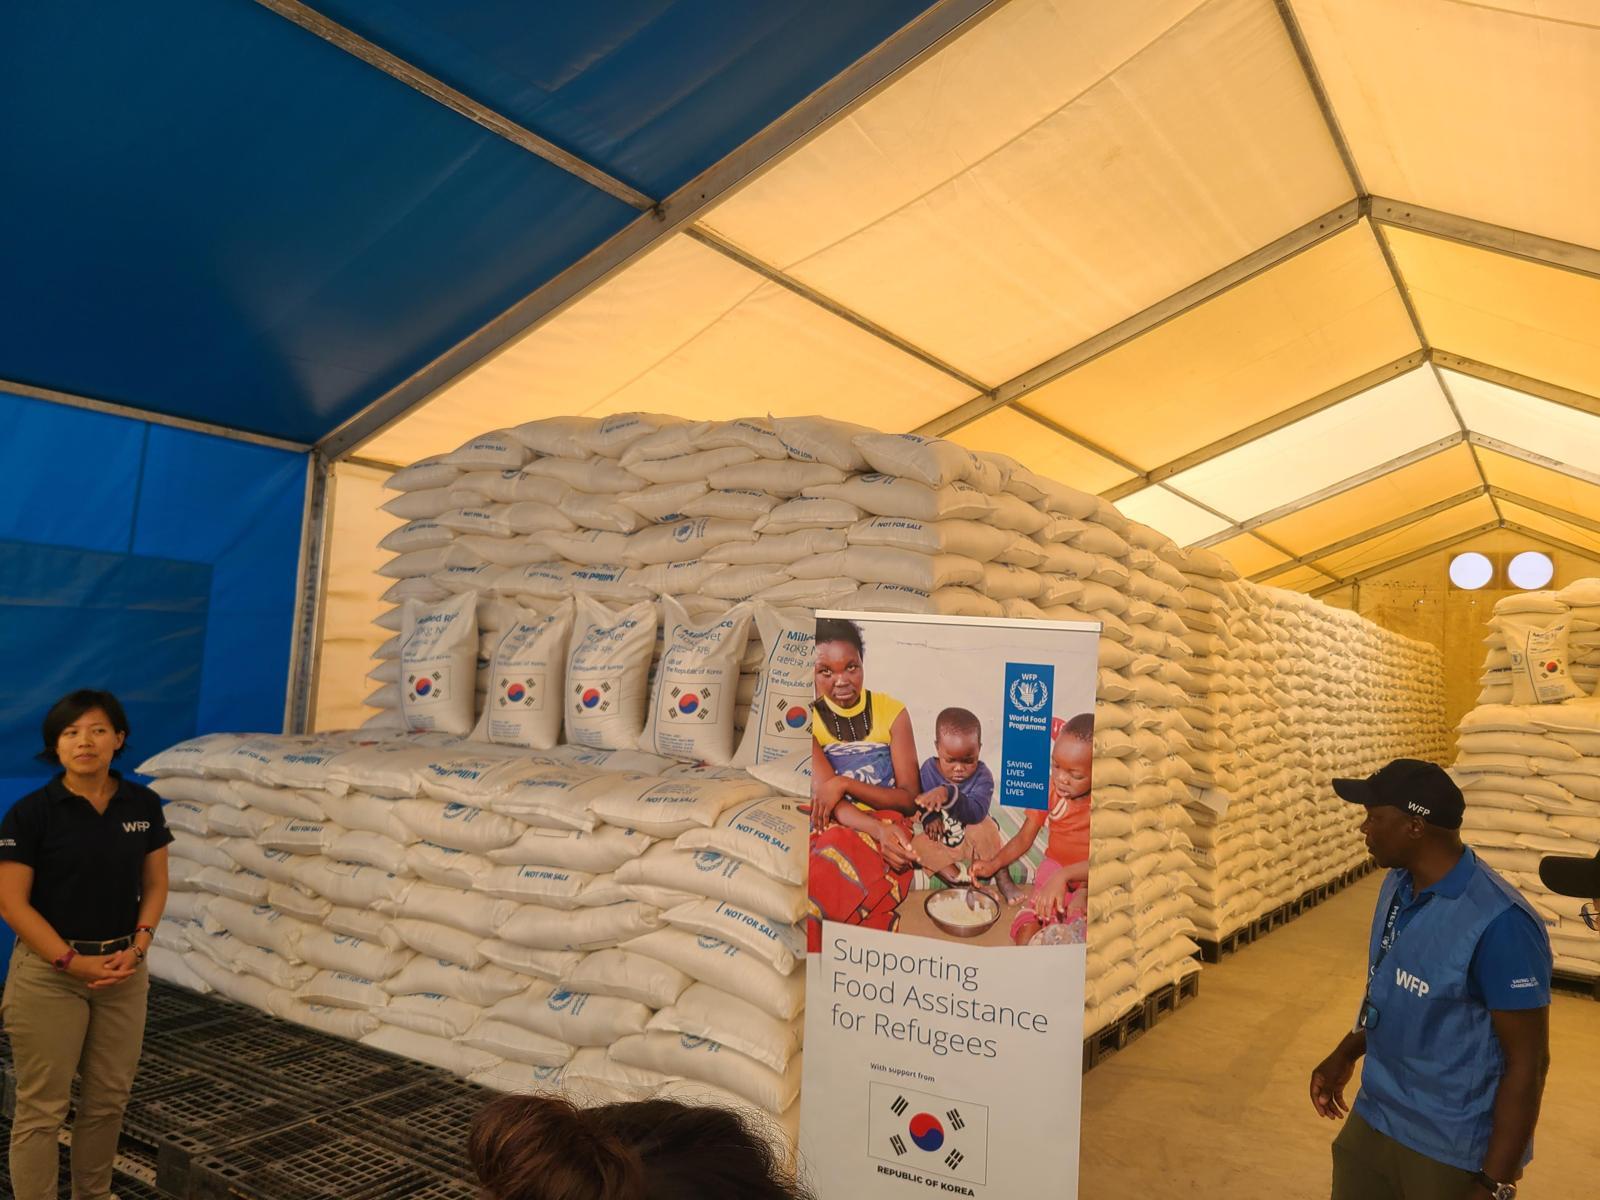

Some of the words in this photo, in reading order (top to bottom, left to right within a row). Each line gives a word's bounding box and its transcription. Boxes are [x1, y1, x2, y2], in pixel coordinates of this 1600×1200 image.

[906, 523, 923, 531] SALE
[1021, 673, 1038, 681] WFP
[1009, 714, 1028, 723] World
[1029, 715, 1047, 724] Food
[1008, 722, 1047, 732] Programme
[1006, 760, 1033, 770] SAVING
[1006, 769, 1025, 777] LIVES
[1005, 780, 1044, 791] CHANGING
[1005, 789, 1025, 797] LIVES
[1408, 801, 1431, 816] WFP
[122, 821, 150, 833] WFP
[736, 823, 754, 834] NOT
[753, 830, 770, 842] FOR
[771, 837, 790, 852] SALE
[524, 870, 540, 878] NOT
[539, 871, 553, 879] FOR
[553, 873, 570, 881] SALE
[724, 908, 743, 920] NOT
[742, 915, 760, 930] FOR
[760, 924, 779, 941] SALE
[833, 938, 979, 992] Supporting
[1395, 967, 1430, 998] WFP
[833, 971, 895, 1004] Food
[903, 985, 1048, 1034] Assistance
[831, 1003, 865, 1032] for
[874, 1013, 997, 1058] Refugees
[870, 1062, 887, 1072] With
[888, 1066, 916, 1078] support
[918, 1072, 935, 1082] from
[877, 1165, 923, 1184] REPUBLIC
[925, 1178, 939, 1188] OF
[940, 1181, 975, 1198] KOREA
